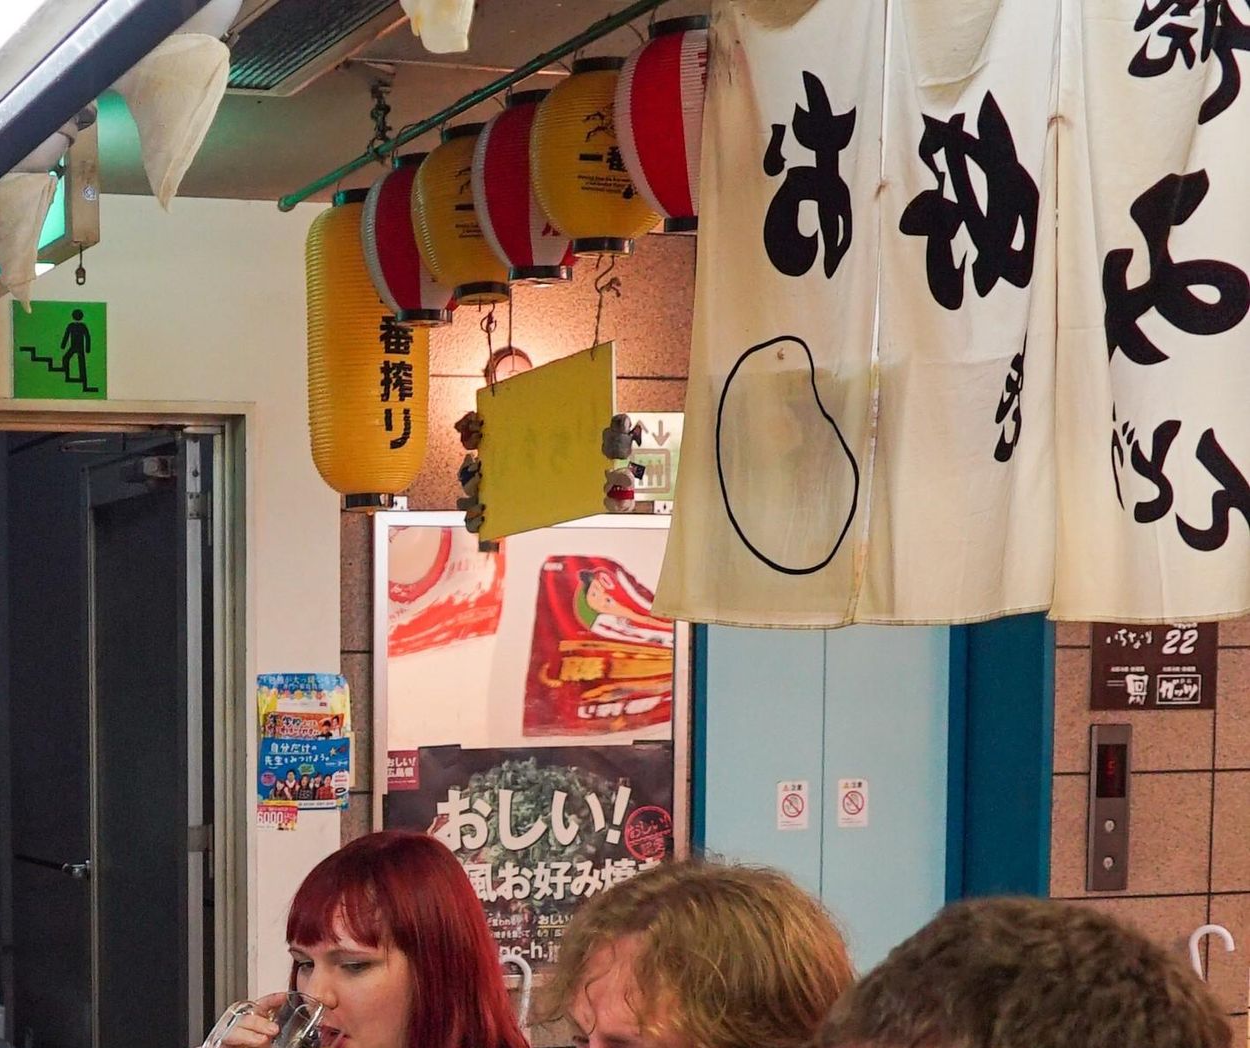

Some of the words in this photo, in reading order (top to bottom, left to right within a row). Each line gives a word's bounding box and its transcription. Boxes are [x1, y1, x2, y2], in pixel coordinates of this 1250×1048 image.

[378, 298, 415, 450] 番搾り
[1161, 628, 1199, 655] 22
[434, 785, 632, 852] おしい!
